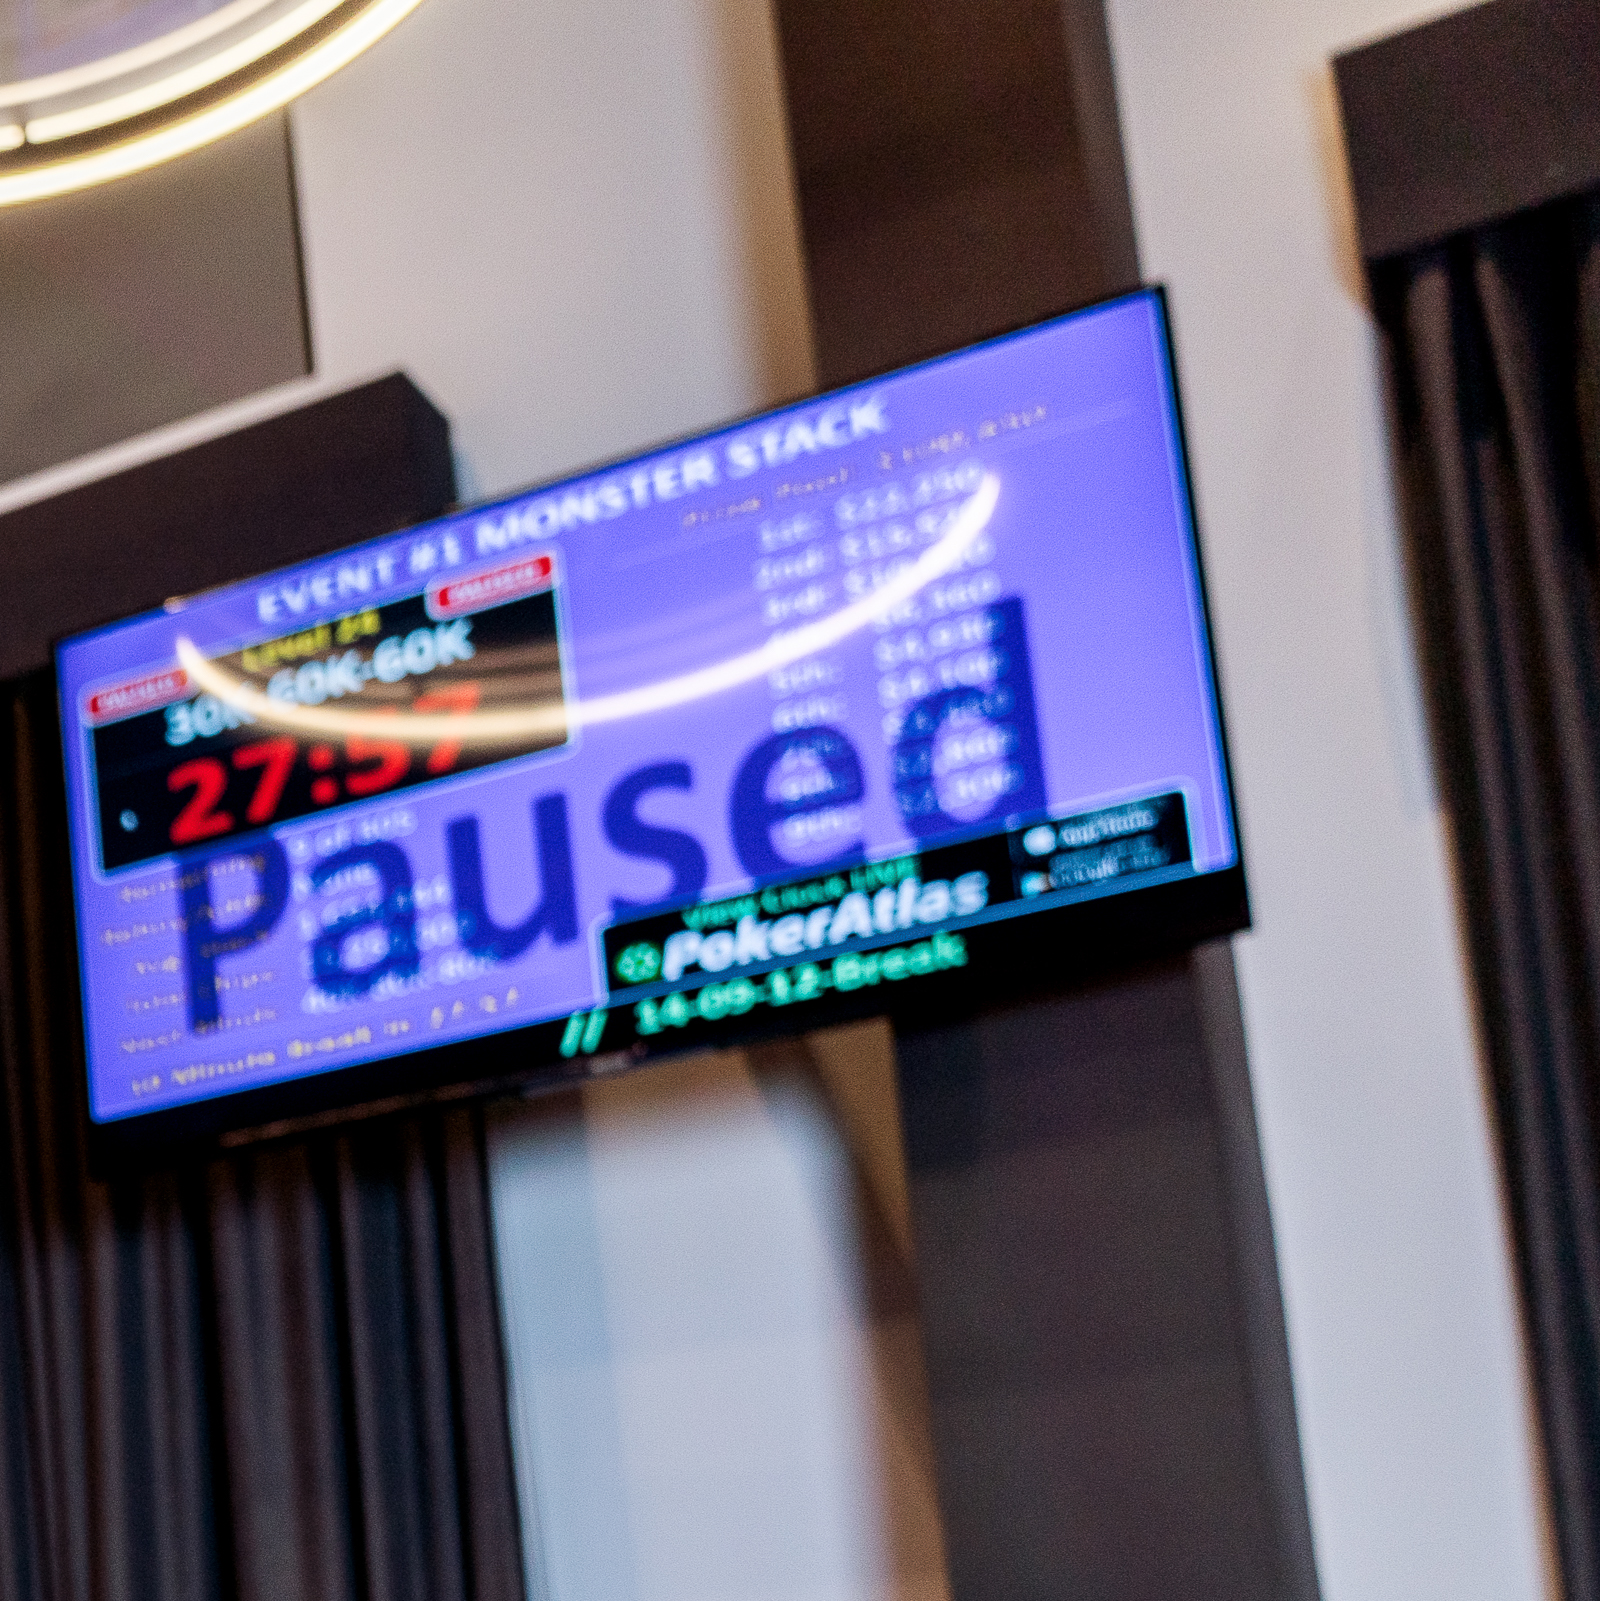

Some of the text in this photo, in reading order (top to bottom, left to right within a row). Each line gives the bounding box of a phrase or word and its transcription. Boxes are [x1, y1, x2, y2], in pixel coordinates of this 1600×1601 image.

[256, 553, 395, 622] EVENT
[412, 534, 460, 572] #1
[477, 452, 716, 554] MONSTER
[726, 396, 887, 477] STACK
[166, 682, 482, 845] 27:57
[170, 594, 1050, 1036] Paused
[658, 868, 991, 983] PokerAtlas
